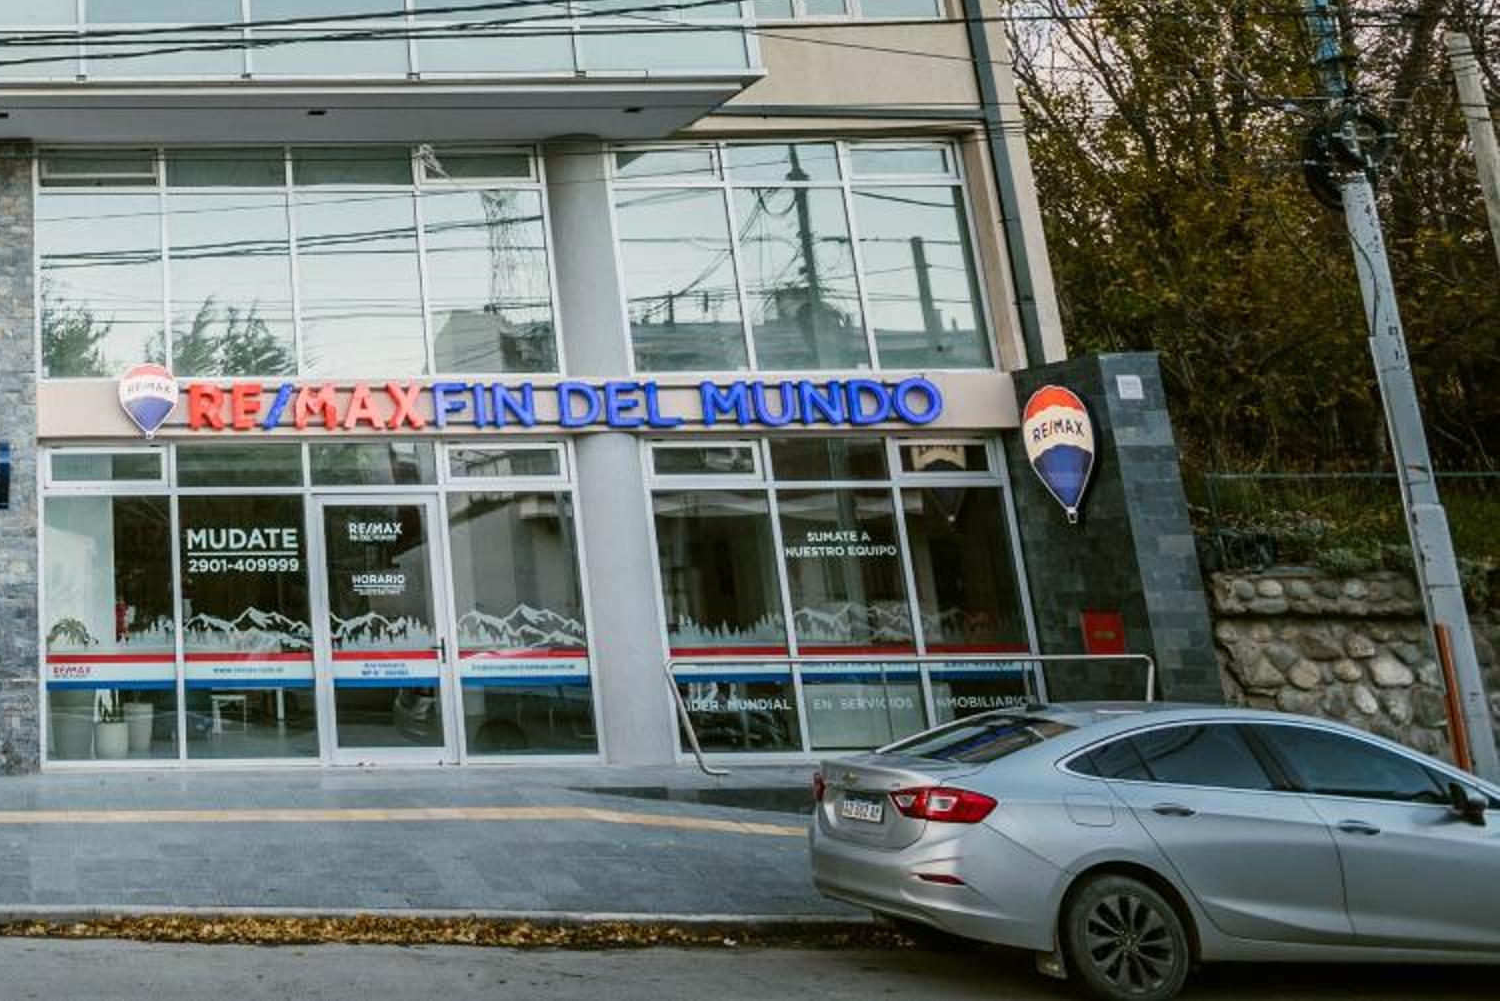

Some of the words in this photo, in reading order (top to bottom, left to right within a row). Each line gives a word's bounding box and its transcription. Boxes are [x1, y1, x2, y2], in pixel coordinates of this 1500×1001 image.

[127, 381, 171, 395] RE/MAX
[187, 381, 426, 431] RE/MAX
[431, 382, 536, 429] FIN
[557, 381, 685, 428] DEL
[700, 378, 943, 427] MUNDO
[1032, 418, 1086, 443] RE/MAX
[348, 522, 403, 534] RE/MAX
[187, 528, 299, 549] MUDATE
[806, 530, 858, 542] SUMATE
[861, 531, 872, 542] A
[785, 545, 845, 558] NUESTRO
[847, 545, 897, 556] EQUIPO
[188, 558, 299, 573] 2901-409999
[351, 574, 405, 584] HORARIO
[683, 699, 719, 712] IDER
[727, 697, 793, 711] MUNDIAL
